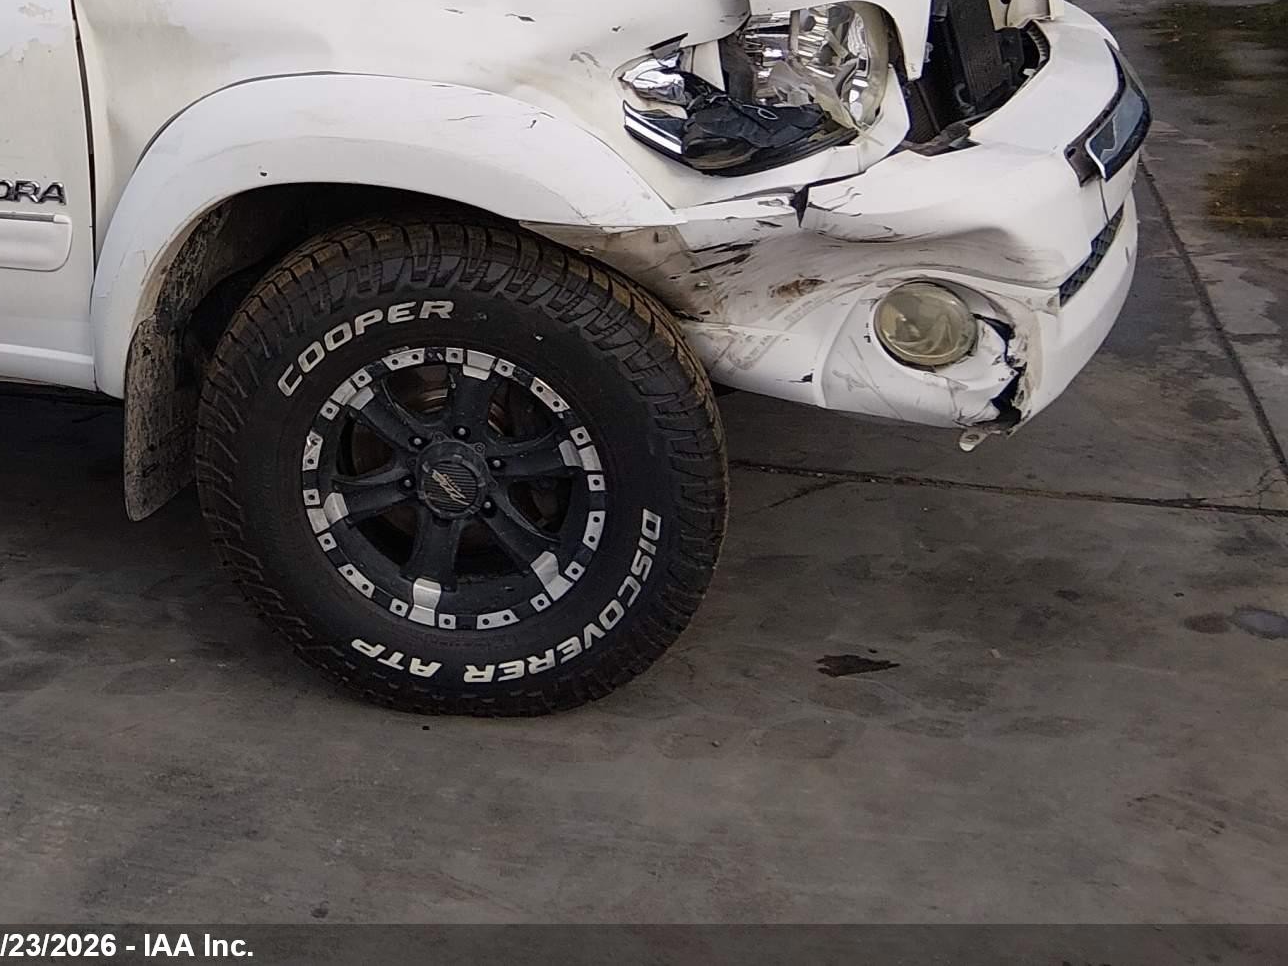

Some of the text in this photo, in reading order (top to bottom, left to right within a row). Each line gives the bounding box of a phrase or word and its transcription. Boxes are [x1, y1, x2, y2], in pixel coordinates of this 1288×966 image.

[277, 300, 454, 397] COOPER
[351, 508, 662, 683] DISCOVERER ATP
